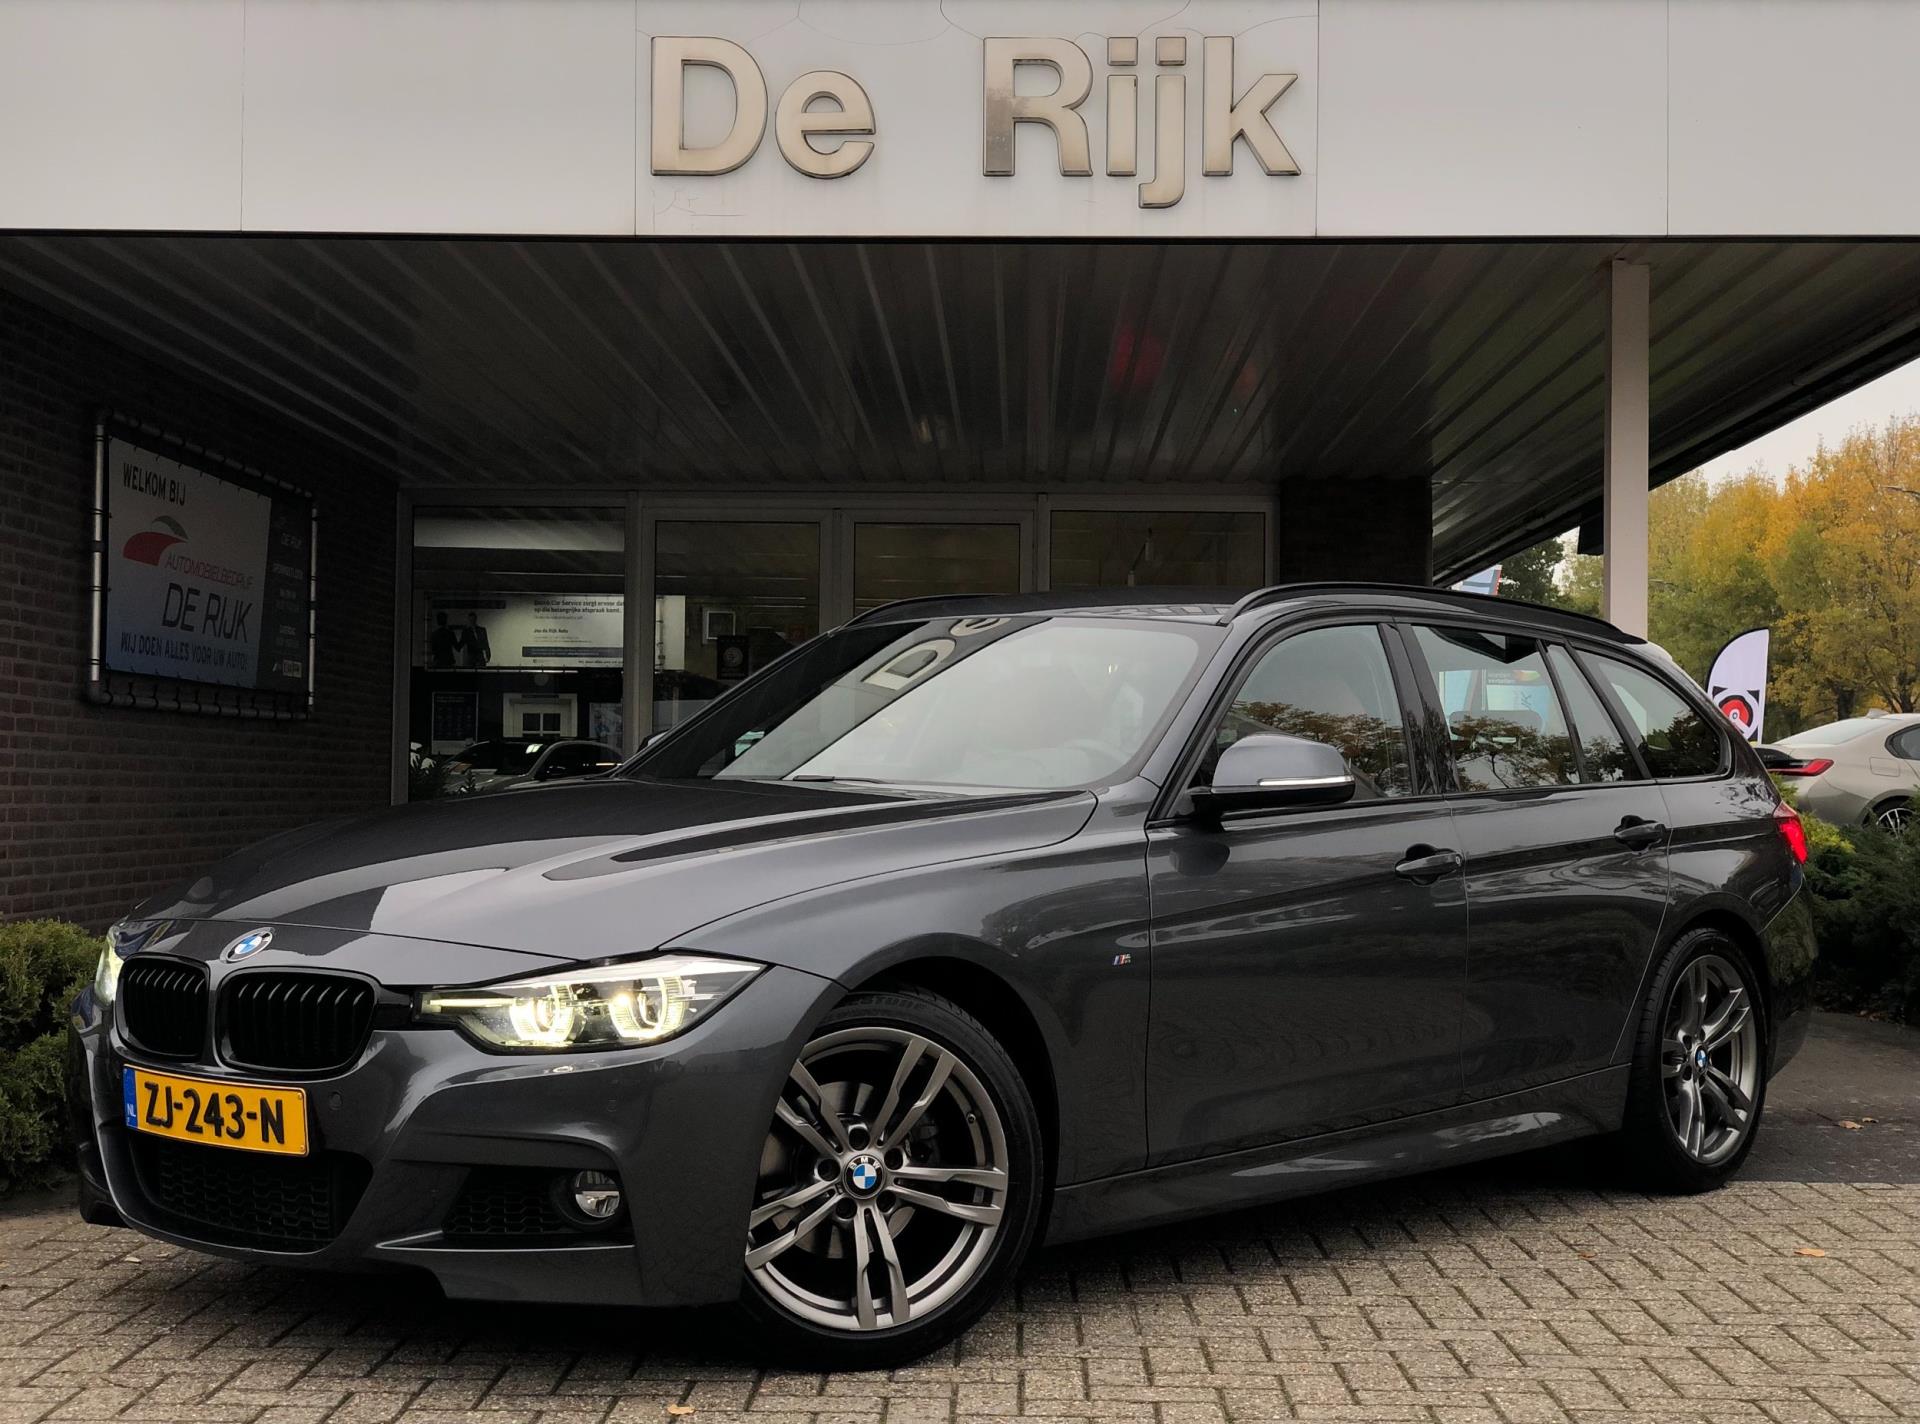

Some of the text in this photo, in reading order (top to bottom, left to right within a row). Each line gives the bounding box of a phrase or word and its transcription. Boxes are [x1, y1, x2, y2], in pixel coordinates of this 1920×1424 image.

[651, 36, 1302, 209] De Rijk
[123, 462, 186, 506] WELKOM BIJ
[162, 582, 253, 643] DE RIJK
[121, 632, 136, 653] WIJ
[138, 635, 162, 657] DOEN
[164, 639, 189, 662] ALLES
[191, 642, 211, 665] VOOR
[127, 1103, 137, 1118] NL
[144, 1082, 285, 1144] ZJ-243-N
